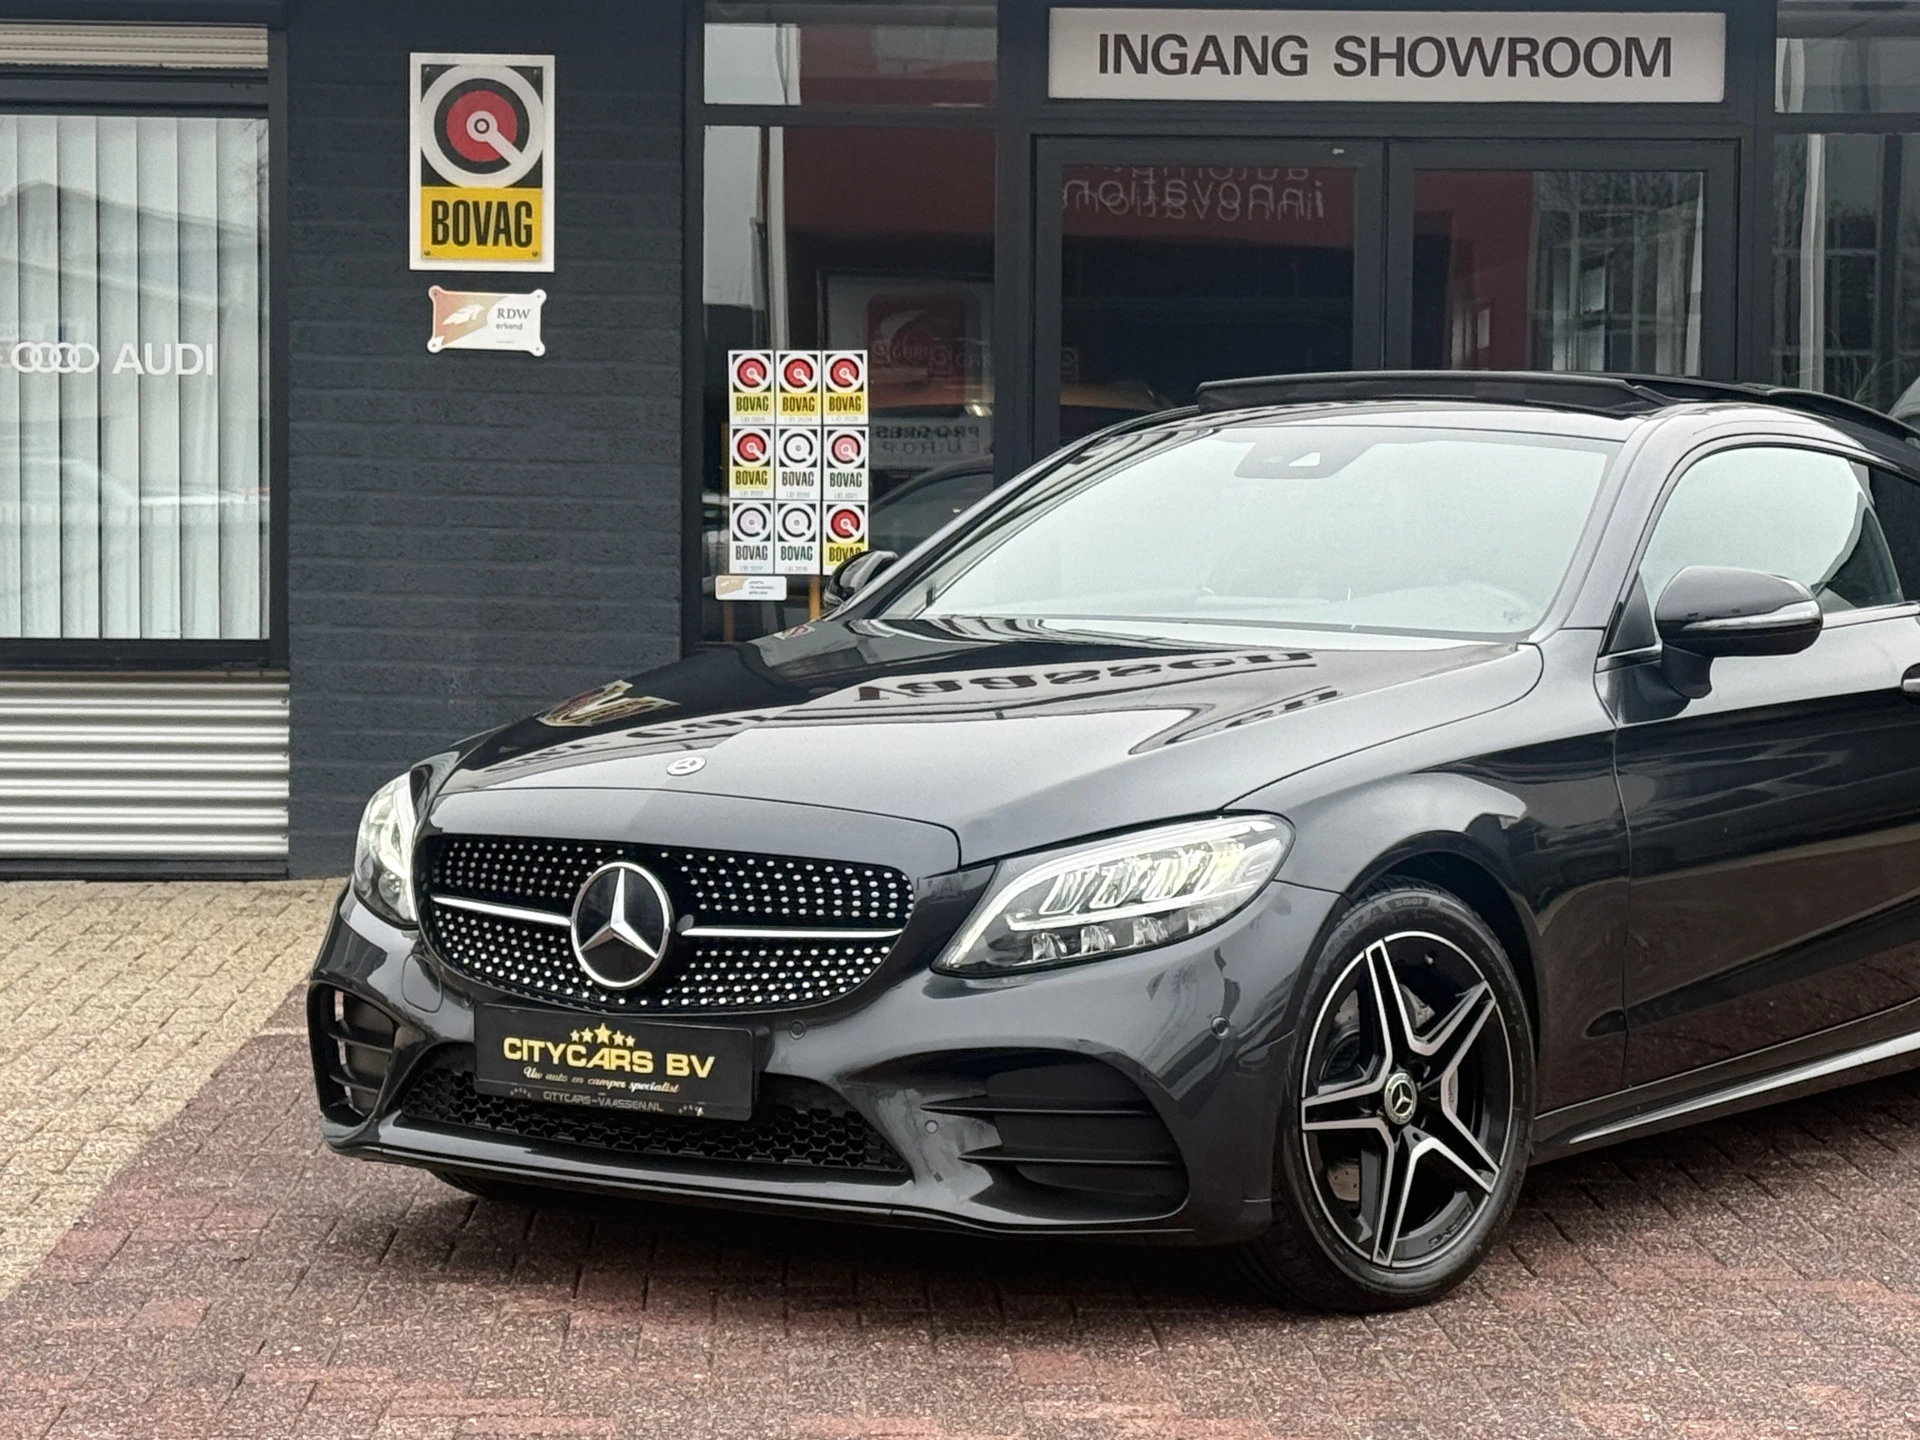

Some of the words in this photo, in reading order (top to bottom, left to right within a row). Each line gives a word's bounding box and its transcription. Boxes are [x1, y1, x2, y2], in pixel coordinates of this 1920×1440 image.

[1098, 33, 1309, 76] INGANG
[1333, 36, 1672, 78] SHOWROOM
[431, 199, 533, 248] BOVAG
[496, 308, 531, 320] RDW
[111, 342, 214, 376] AUDI
[736, 396, 769, 412] BOVAG
[782, 396, 815, 412] BOVAG
[828, 395, 861, 412] BOVAG
[735, 470, 768, 486] BOVAG
[782, 471, 814, 487] BOVAG
[829, 472, 862, 488] BOVAG
[735, 545, 768, 561] BOVAG
[780, 546, 813, 561] BOVAG
[503, 1036, 654, 1075] CITYCARS
[665, 1052, 716, 1079] BV
[522, 1066, 543, 1079] Uw
[545, 1072, 568, 1083] auto
[570, 1076, 585, 1085] en
[628, 1080, 681, 1094] specialist
